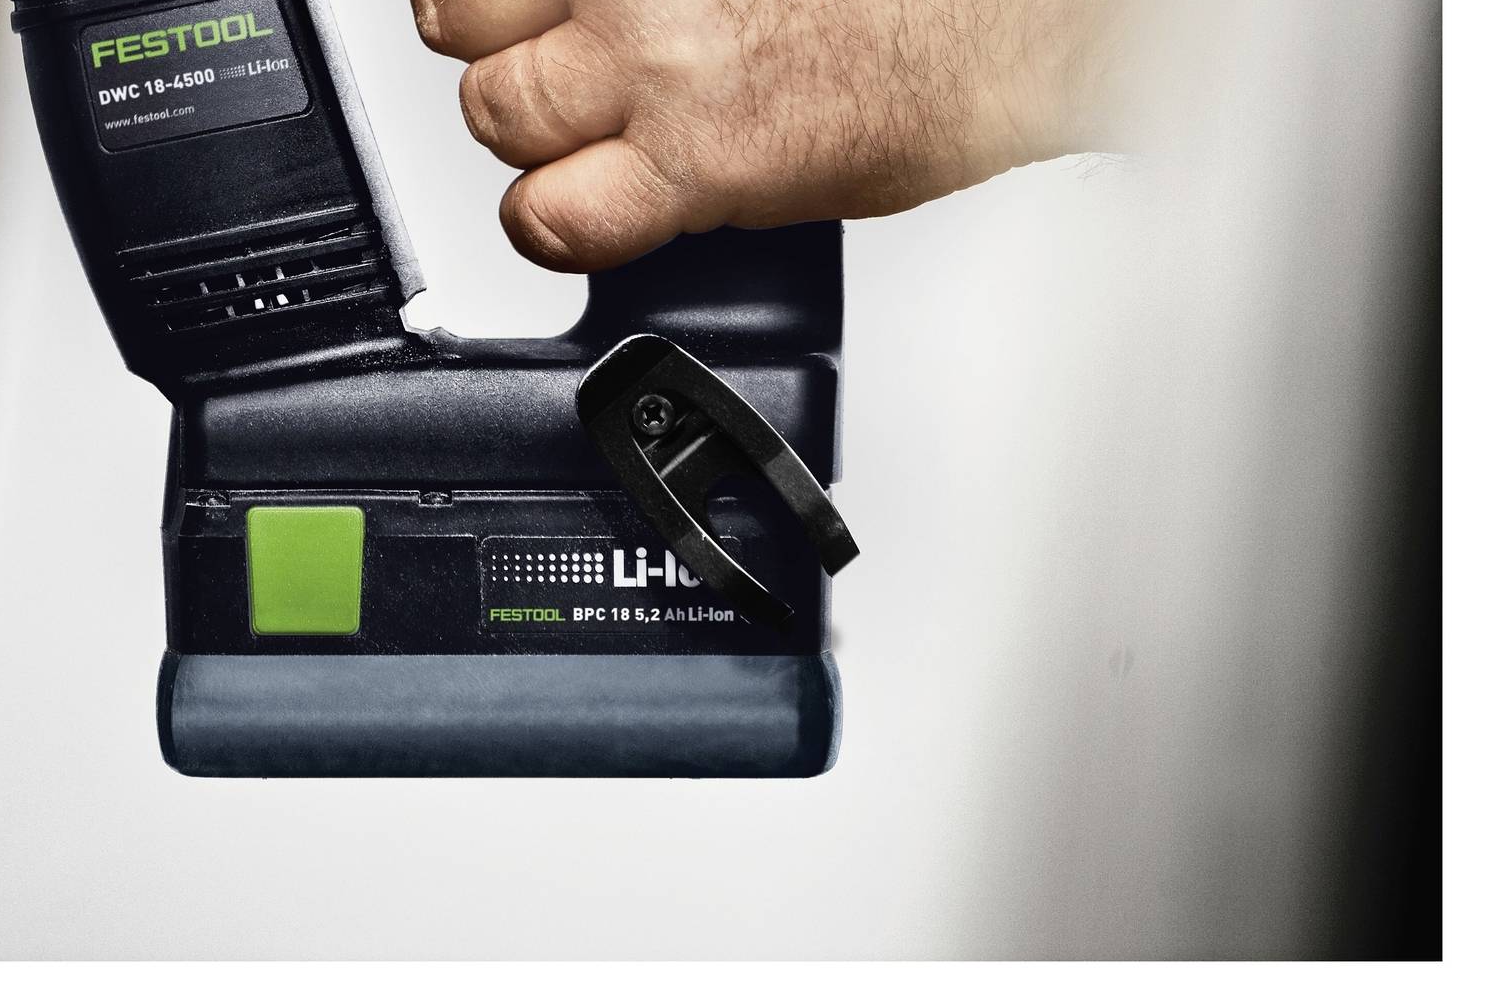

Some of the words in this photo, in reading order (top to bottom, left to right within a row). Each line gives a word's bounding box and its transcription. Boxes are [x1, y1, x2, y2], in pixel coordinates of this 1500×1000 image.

[90, 12, 275, 69] FESTOOL
[98, 84, 140, 106] DWC
[144, 68, 215, 96] 18-4500
[248, 58, 290, 76] Li-Ion
[104, 104, 195, 130] www.festool.com
[613, 547, 701, 588] Li-I
[490, 608, 566, 622] FESTOOL
[572, 607, 606, 621] BPC
[611, 607, 630, 621] 18
[634, 607, 660, 624] 5,2
[664, 607, 685, 622] Ah
[688, 606, 735, 622] Li-Ion
